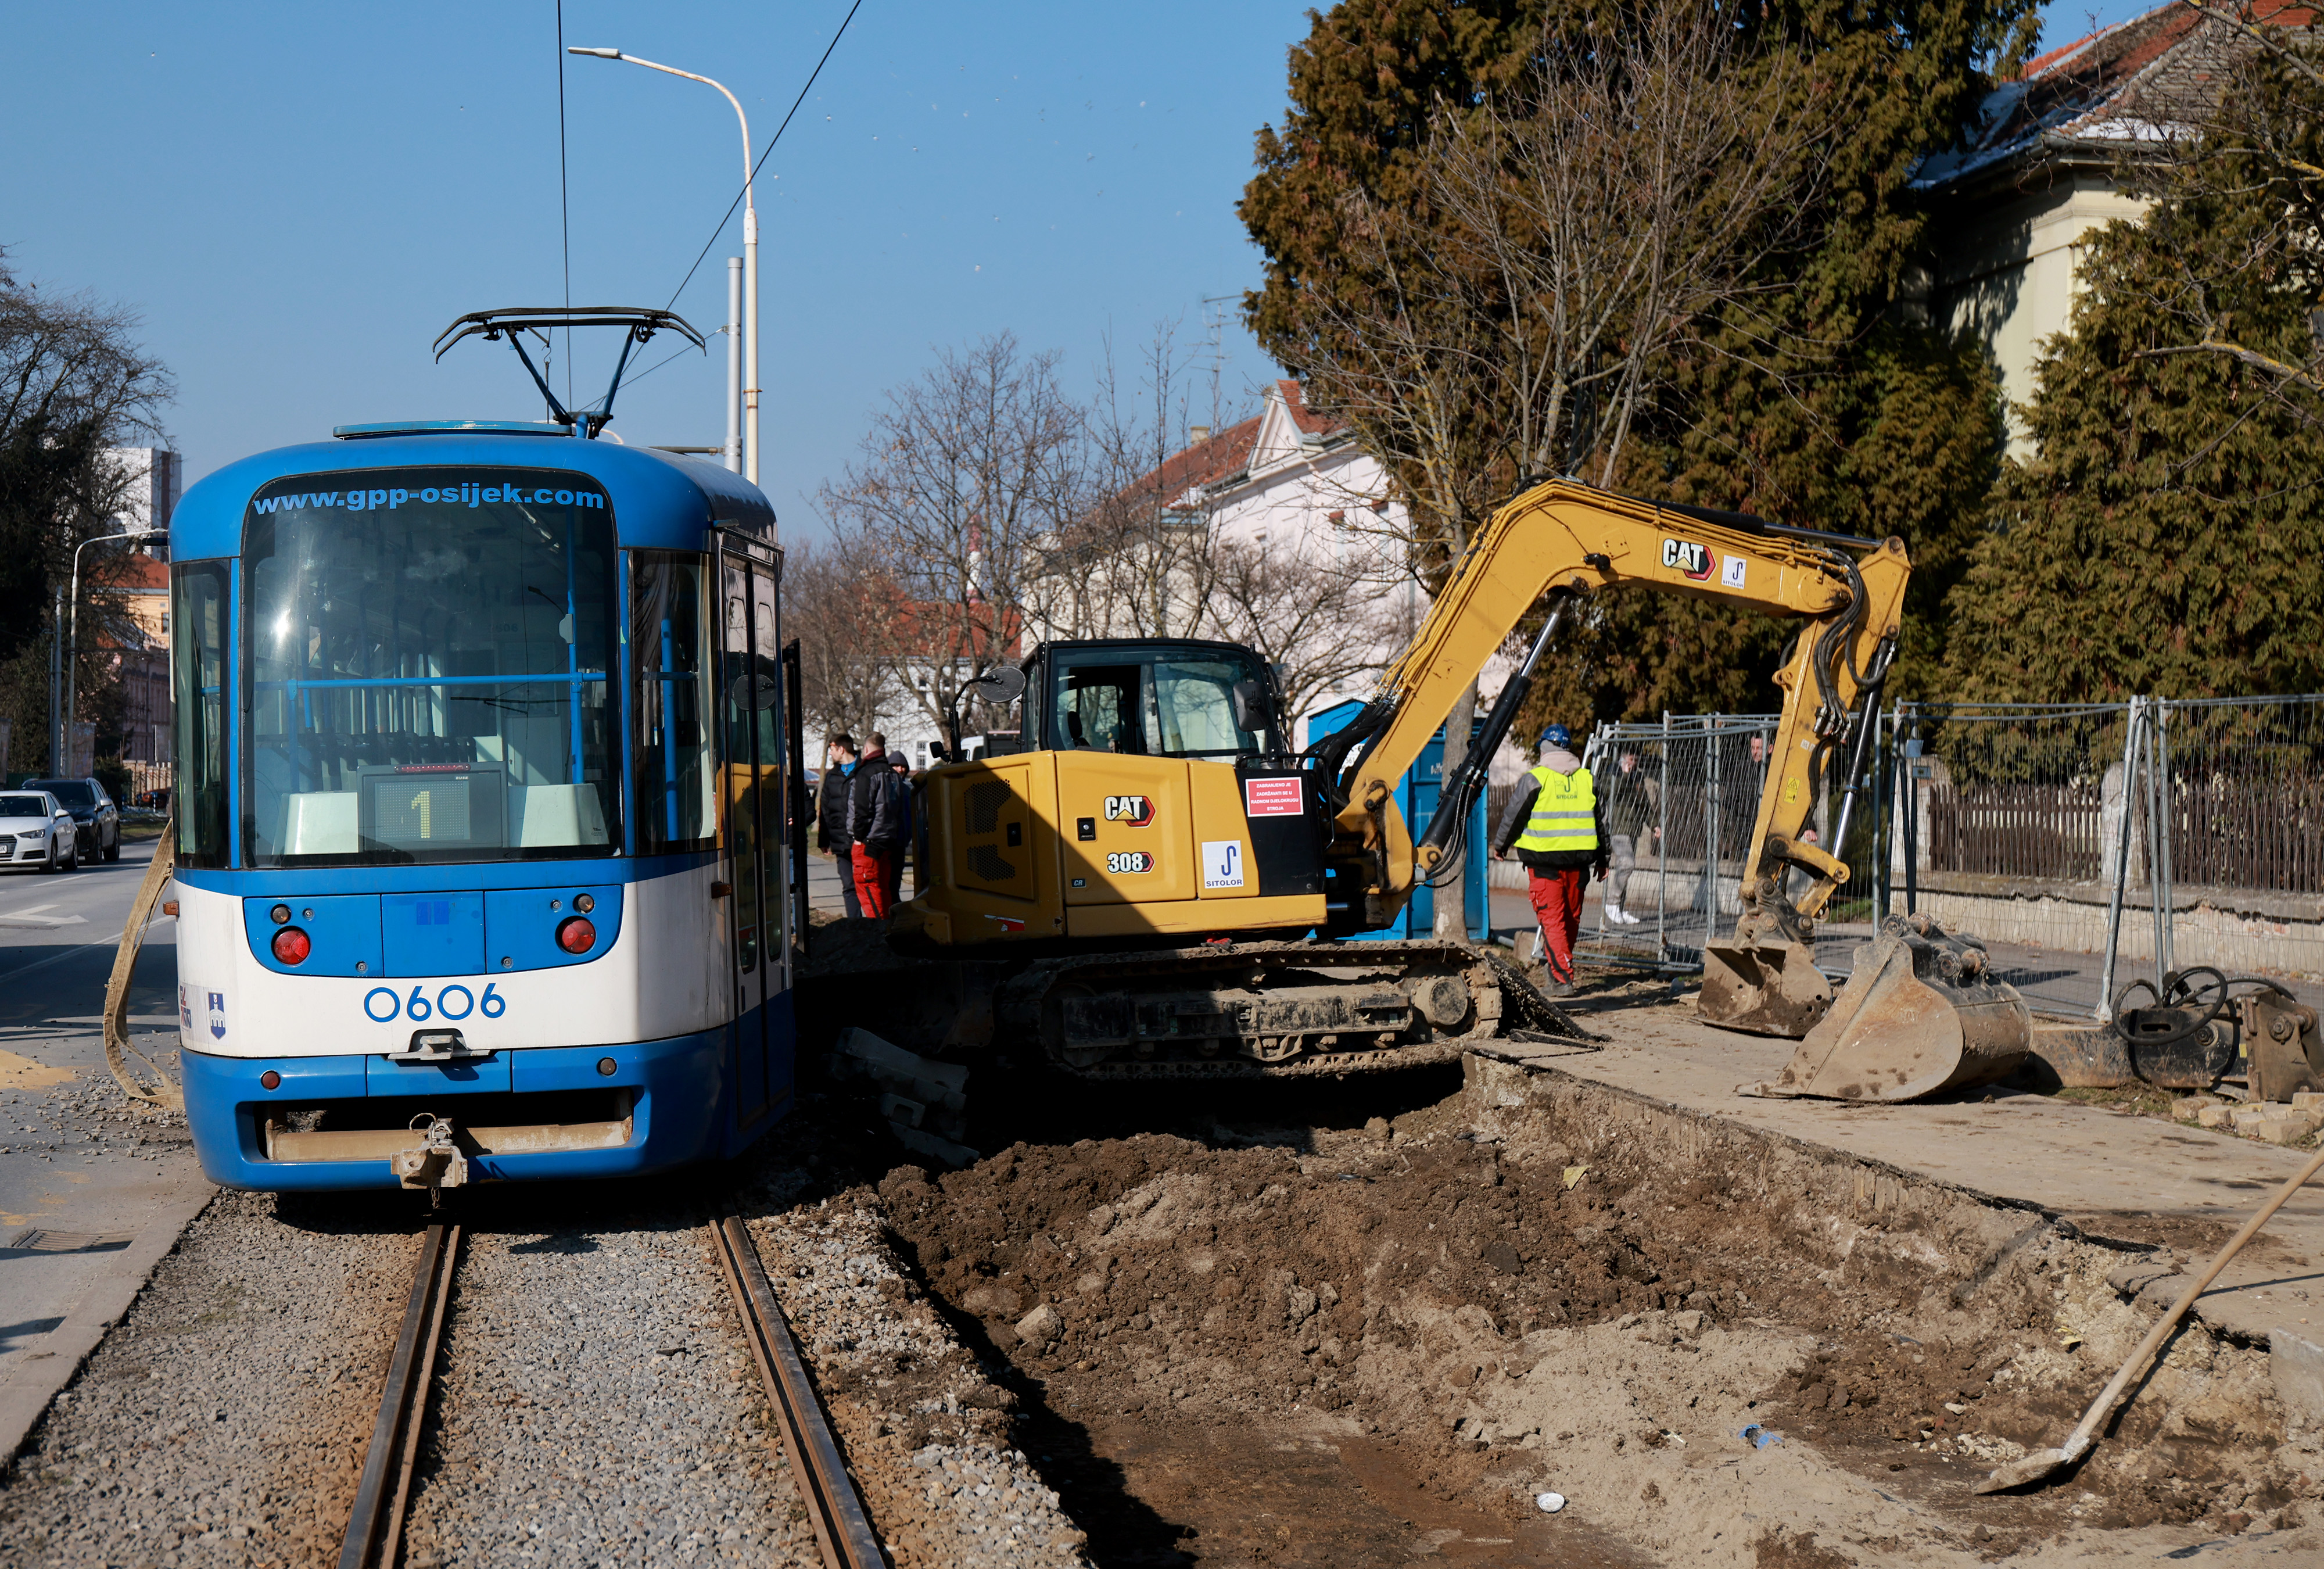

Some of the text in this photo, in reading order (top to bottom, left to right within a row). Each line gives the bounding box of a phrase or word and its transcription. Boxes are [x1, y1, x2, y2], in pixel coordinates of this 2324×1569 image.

[254, 482, 604, 515] www.gpp-osijek.com
[1662, 538, 1704, 572] CAT
[1723, 579, 1744, 588] SITOLOR
[411, 791, 431, 839] 1
[1104, 796, 1143, 821] CAT
[1107, 852, 1143, 872] 308
[1206, 879, 1243, 887] SITOLOR
[364, 983, 506, 1023] 0606
